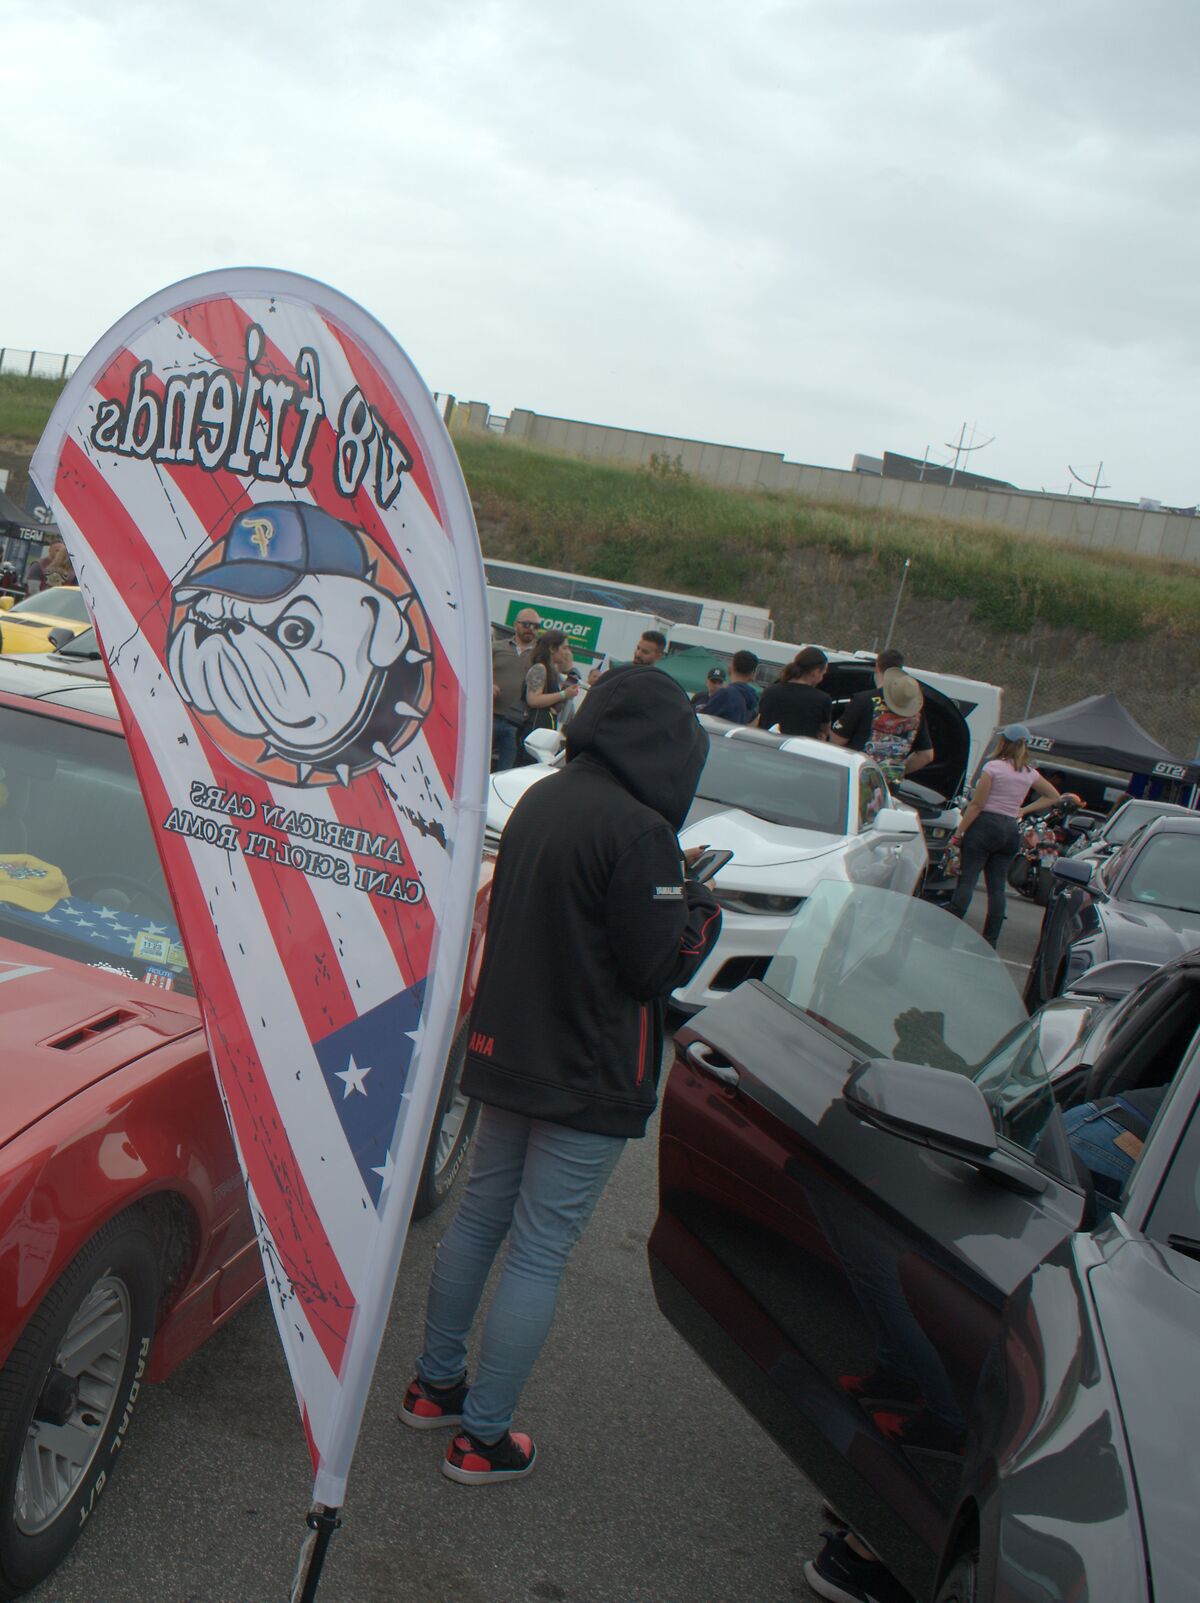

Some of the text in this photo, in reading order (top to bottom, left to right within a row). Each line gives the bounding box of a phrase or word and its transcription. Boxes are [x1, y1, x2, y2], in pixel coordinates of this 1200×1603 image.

[20, 528, 44, 541] TEAM
[539, 616, 591, 636] ropcar
[1028, 735, 1055, 748] T2i
[1153, 762, 1188, 778] GT2i
[469, 1031, 495, 1057] AHA
[111, 1337, 150, 1454] RADIAL
